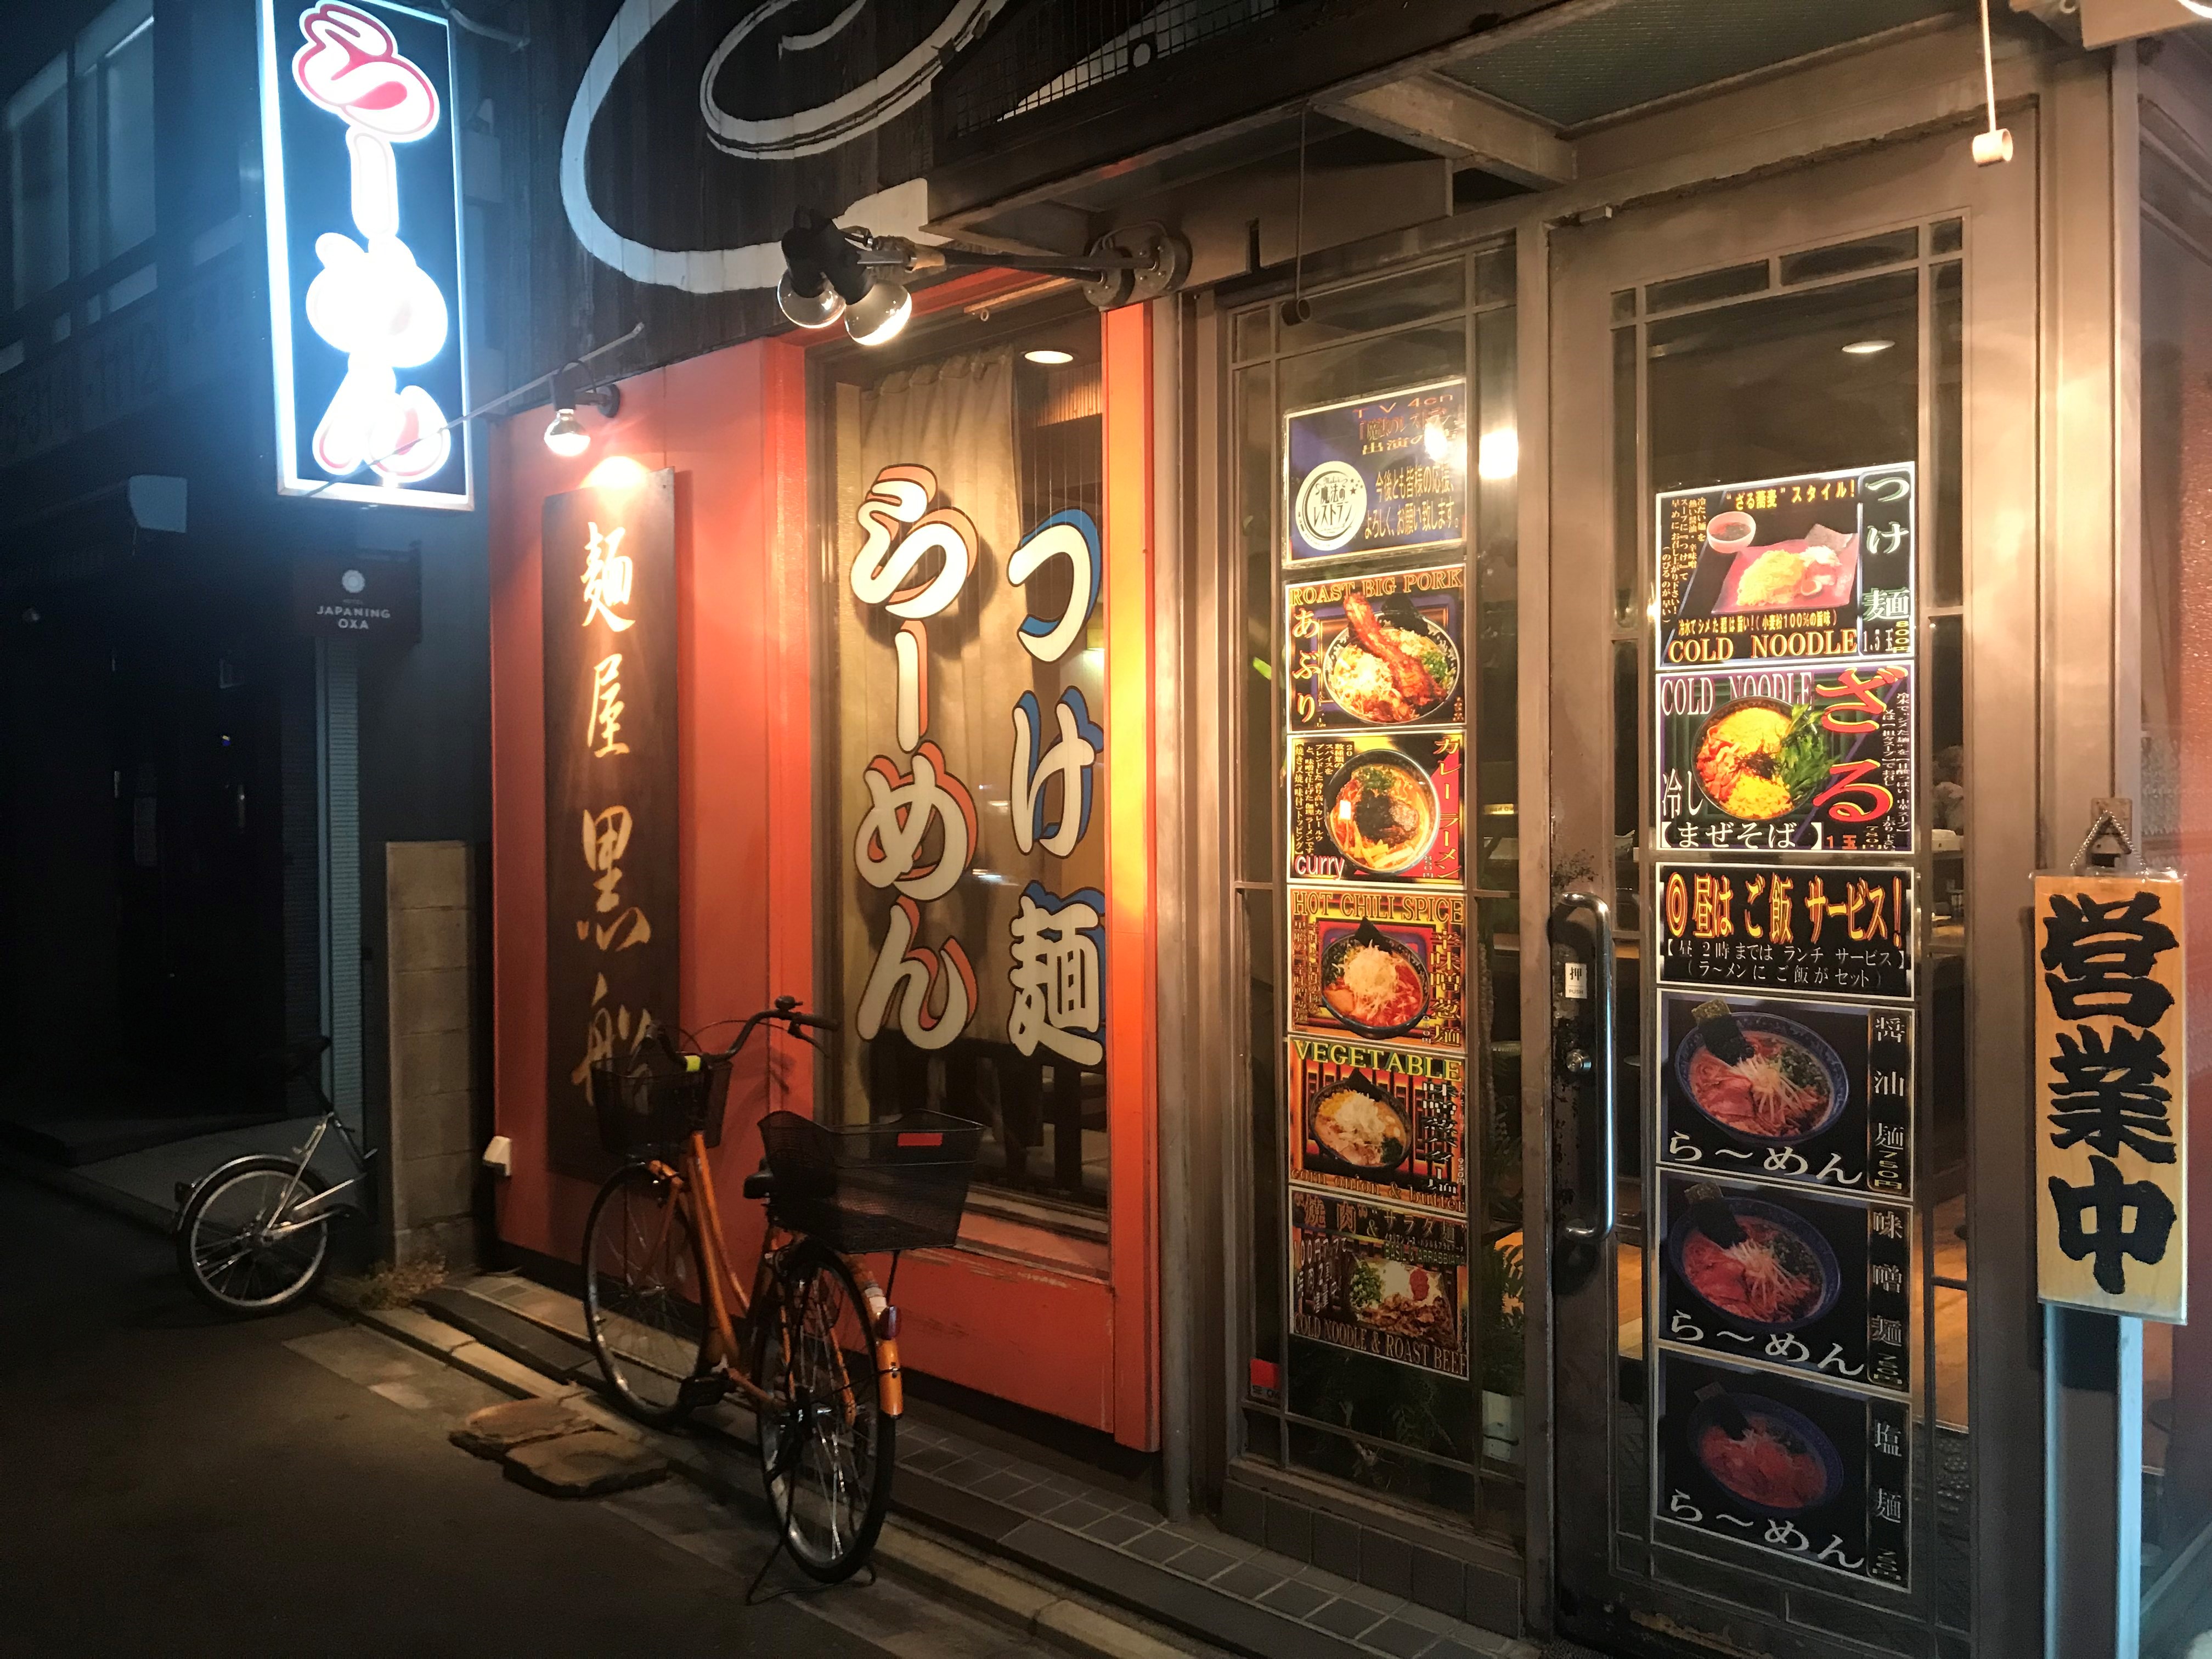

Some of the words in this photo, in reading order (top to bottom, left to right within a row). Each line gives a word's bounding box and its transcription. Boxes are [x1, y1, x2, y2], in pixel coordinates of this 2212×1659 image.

[1863, 476, 1911, 622] つけ麺
[1289, 581, 1356, 606] ROAST
[1362, 577, 1397, 597] BIG
[1403, 568, 1464, 593] PORK
[316, 605, 391, 618] JAPANING
[338, 618, 369, 630] OXA
[1291, 607, 1322, 723] あぶり
[1668, 636, 1734, 663] COLD
[1751, 628, 1859, 659] NOODLE
[1661, 676, 1714, 716] COLD
[1729, 671, 1814, 711] NOODLE
[849, 462, 981, 1051] らーめん
[1813, 665, 1908, 823] ざる
[1007, 506, 1106, 1069] つけ麺
[1662, 768, 1705, 820] 冷し
[1295, 854, 1345, 881] curry
[1293, 891, 1333, 916] HOT
[1341, 893, 1395, 920] CHILI
[1402, 895, 1464, 924] SPICE
[1293, 1039, 1463, 1082] VEGETABLE
[2043, 890, 2180, 1295] 営業中
[1290, 1168, 1328, 1187] corn
[1333, 1172, 1381, 1197] onion
[1389, 1183, 1402, 1200] &
[1874, 1151, 1903, 1190] 750円
[1294, 1313, 1321, 1336] COLD
[1323, 1319, 1367, 1351] NOODLE
[1370, 1333, 1381, 1353] &
[1386, 1334, 1430, 1367] ROAST
[1433, 1346, 1467, 1376] BEEF
